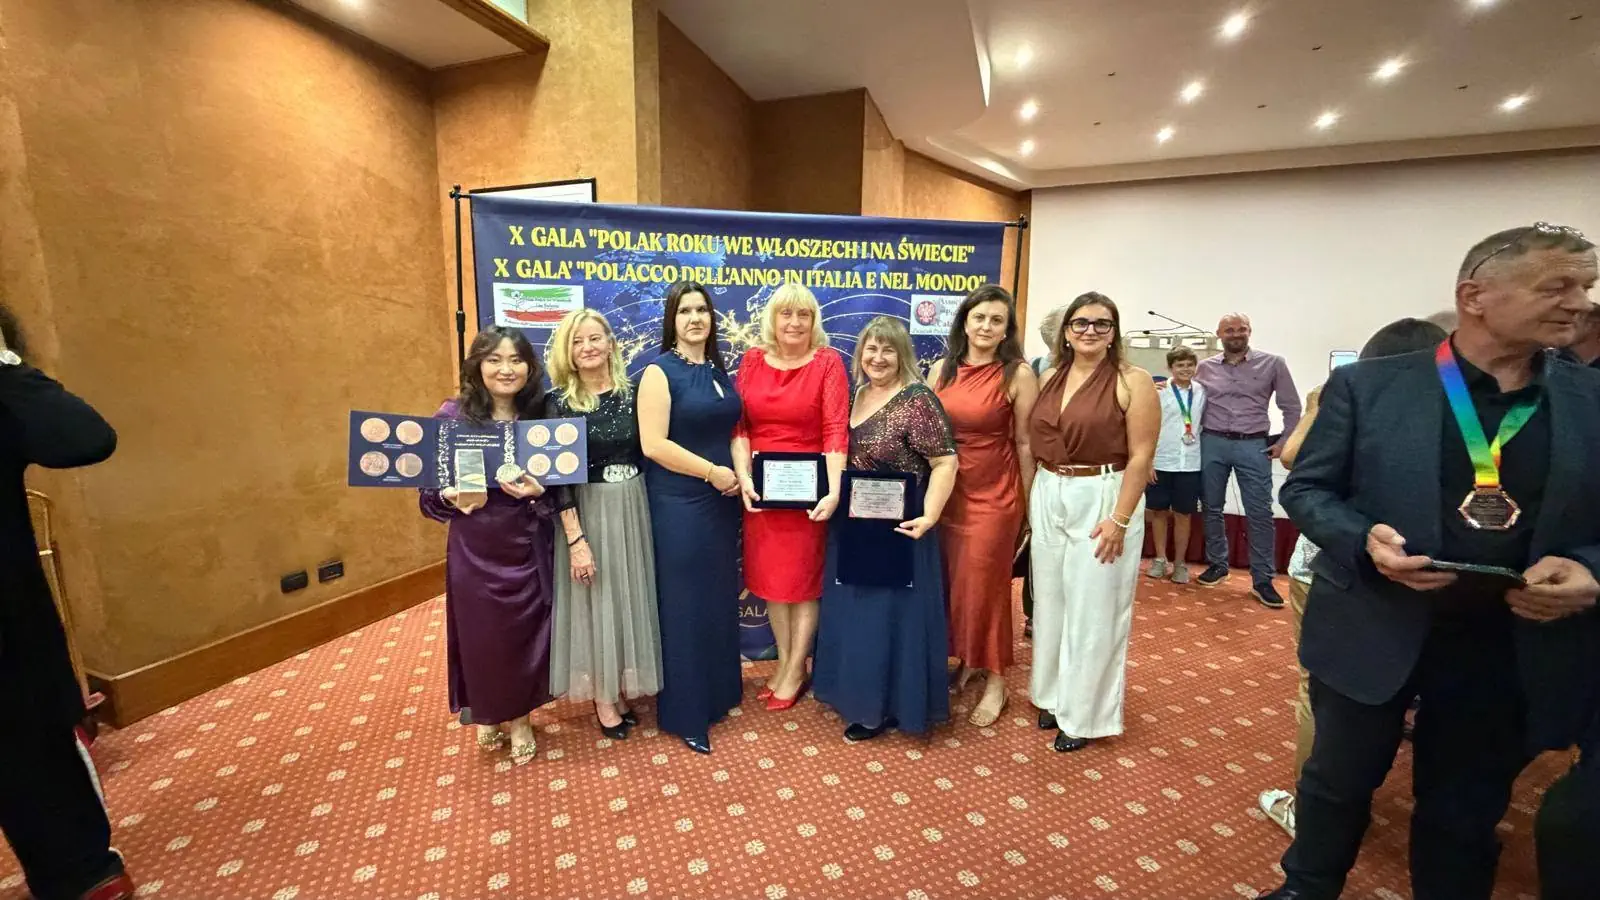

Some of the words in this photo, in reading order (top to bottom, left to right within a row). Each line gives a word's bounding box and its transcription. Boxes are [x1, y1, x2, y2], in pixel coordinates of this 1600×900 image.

[508, 225, 525, 246] X
[531, 226, 587, 248] GALA
[589, 228, 664, 252] "POLAK
[666, 233, 720, 254] ROKU
[723, 235, 753, 256] WE
[755, 237, 858, 259] WŁOSZECH
[861, 241, 868, 259] I
[870, 241, 896, 260] NA
[897, 236, 975, 263] ŚWIECIE"
[493, 258, 510, 278] X
[516, 259, 573, 279] GALA'
[576, 261, 678, 283] "POLACCO
[681, 266, 781, 287] DELL'ANNO
[784, 269, 803, 285] IN
[806, 270, 863, 289] ITALIA
[866, 271, 877, 289] E
[880, 271, 912, 290] NEL
[915, 273, 987, 292] MONDO"
